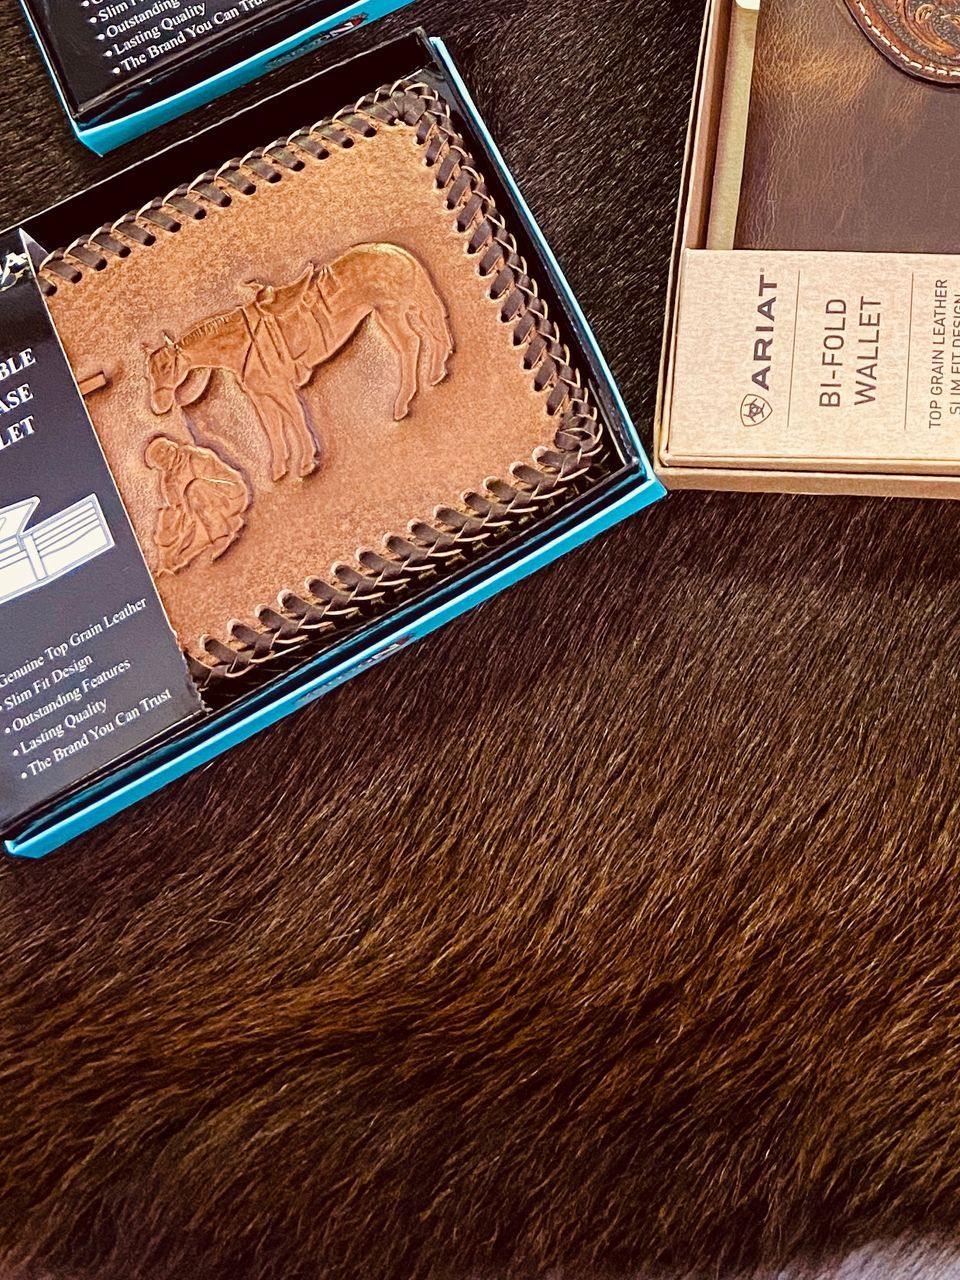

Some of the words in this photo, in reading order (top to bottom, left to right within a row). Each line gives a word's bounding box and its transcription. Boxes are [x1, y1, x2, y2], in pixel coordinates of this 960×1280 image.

[98, 2, 129, 22] Slim
[113, 25, 161, 56] Lasting
[160, 2, 207, 31] Quality
[120, 53, 148, 72] The
[147, 31, 187, 59] Brand
[185, 21, 213, 38] You
[213, 8, 240, 26] Can
[752, 274, 777, 391] ARIAT
[933, 279, 947, 345] LEATHER
[819, 299, 847, 407] BI-FOLD
[854, 296, 881, 405] WALLET
[930, 350, 944, 395] GRAIN
[929, 400, 942, 429] TOP
[0, 656, 45, 687] Genuine
[45, 642, 68, 661] Top
[69, 623, 103, 647] Grain
[103, 598, 147, 628] Leather
[4, 690, 32, 711] Slim
[33, 677, 51, 694] Fit
[51, 655, 93, 683] Design
[12, 686, 84, 731] Outstanding
[81, 659, 131, 693] Features
[20, 723, 64, 754] Lasting
[64, 698, 108, 728] Quality
[27, 755, 52, 776] The
[53, 733, 90, 762] Brand
[89, 724, 114, 740] You
[115, 707, 140, 726] Can
[139, 688, 172, 713] Trust
